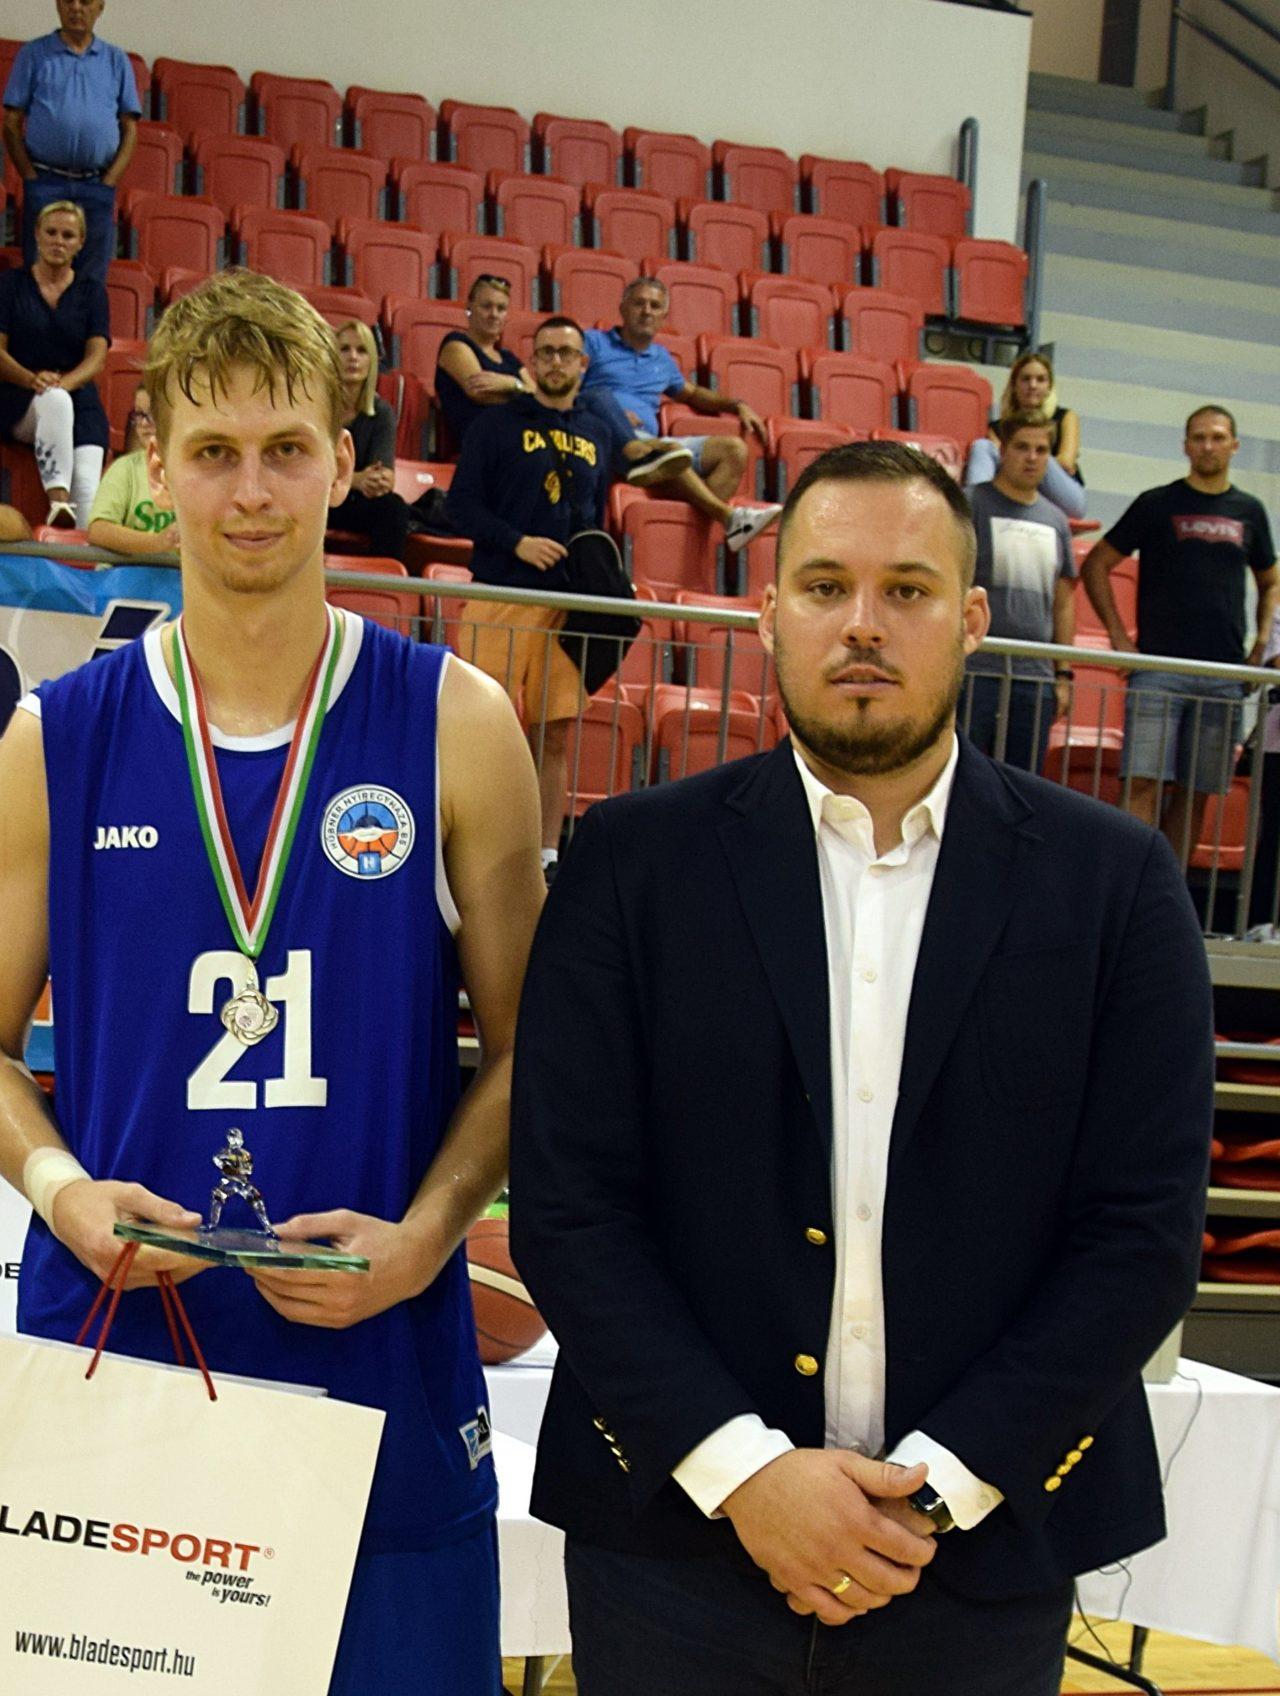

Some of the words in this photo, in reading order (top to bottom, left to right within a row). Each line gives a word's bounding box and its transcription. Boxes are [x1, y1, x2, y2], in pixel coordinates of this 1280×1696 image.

[94, 825, 159, 850] JAKO
[187, 949, 328, 1110] 21
[185, 1571, 201, 1582] the
[201, 1571, 255, 1589] power
[219, 1588, 271, 1607] yours!
[15, 1630, 195, 1676] www.bladesport.hu
